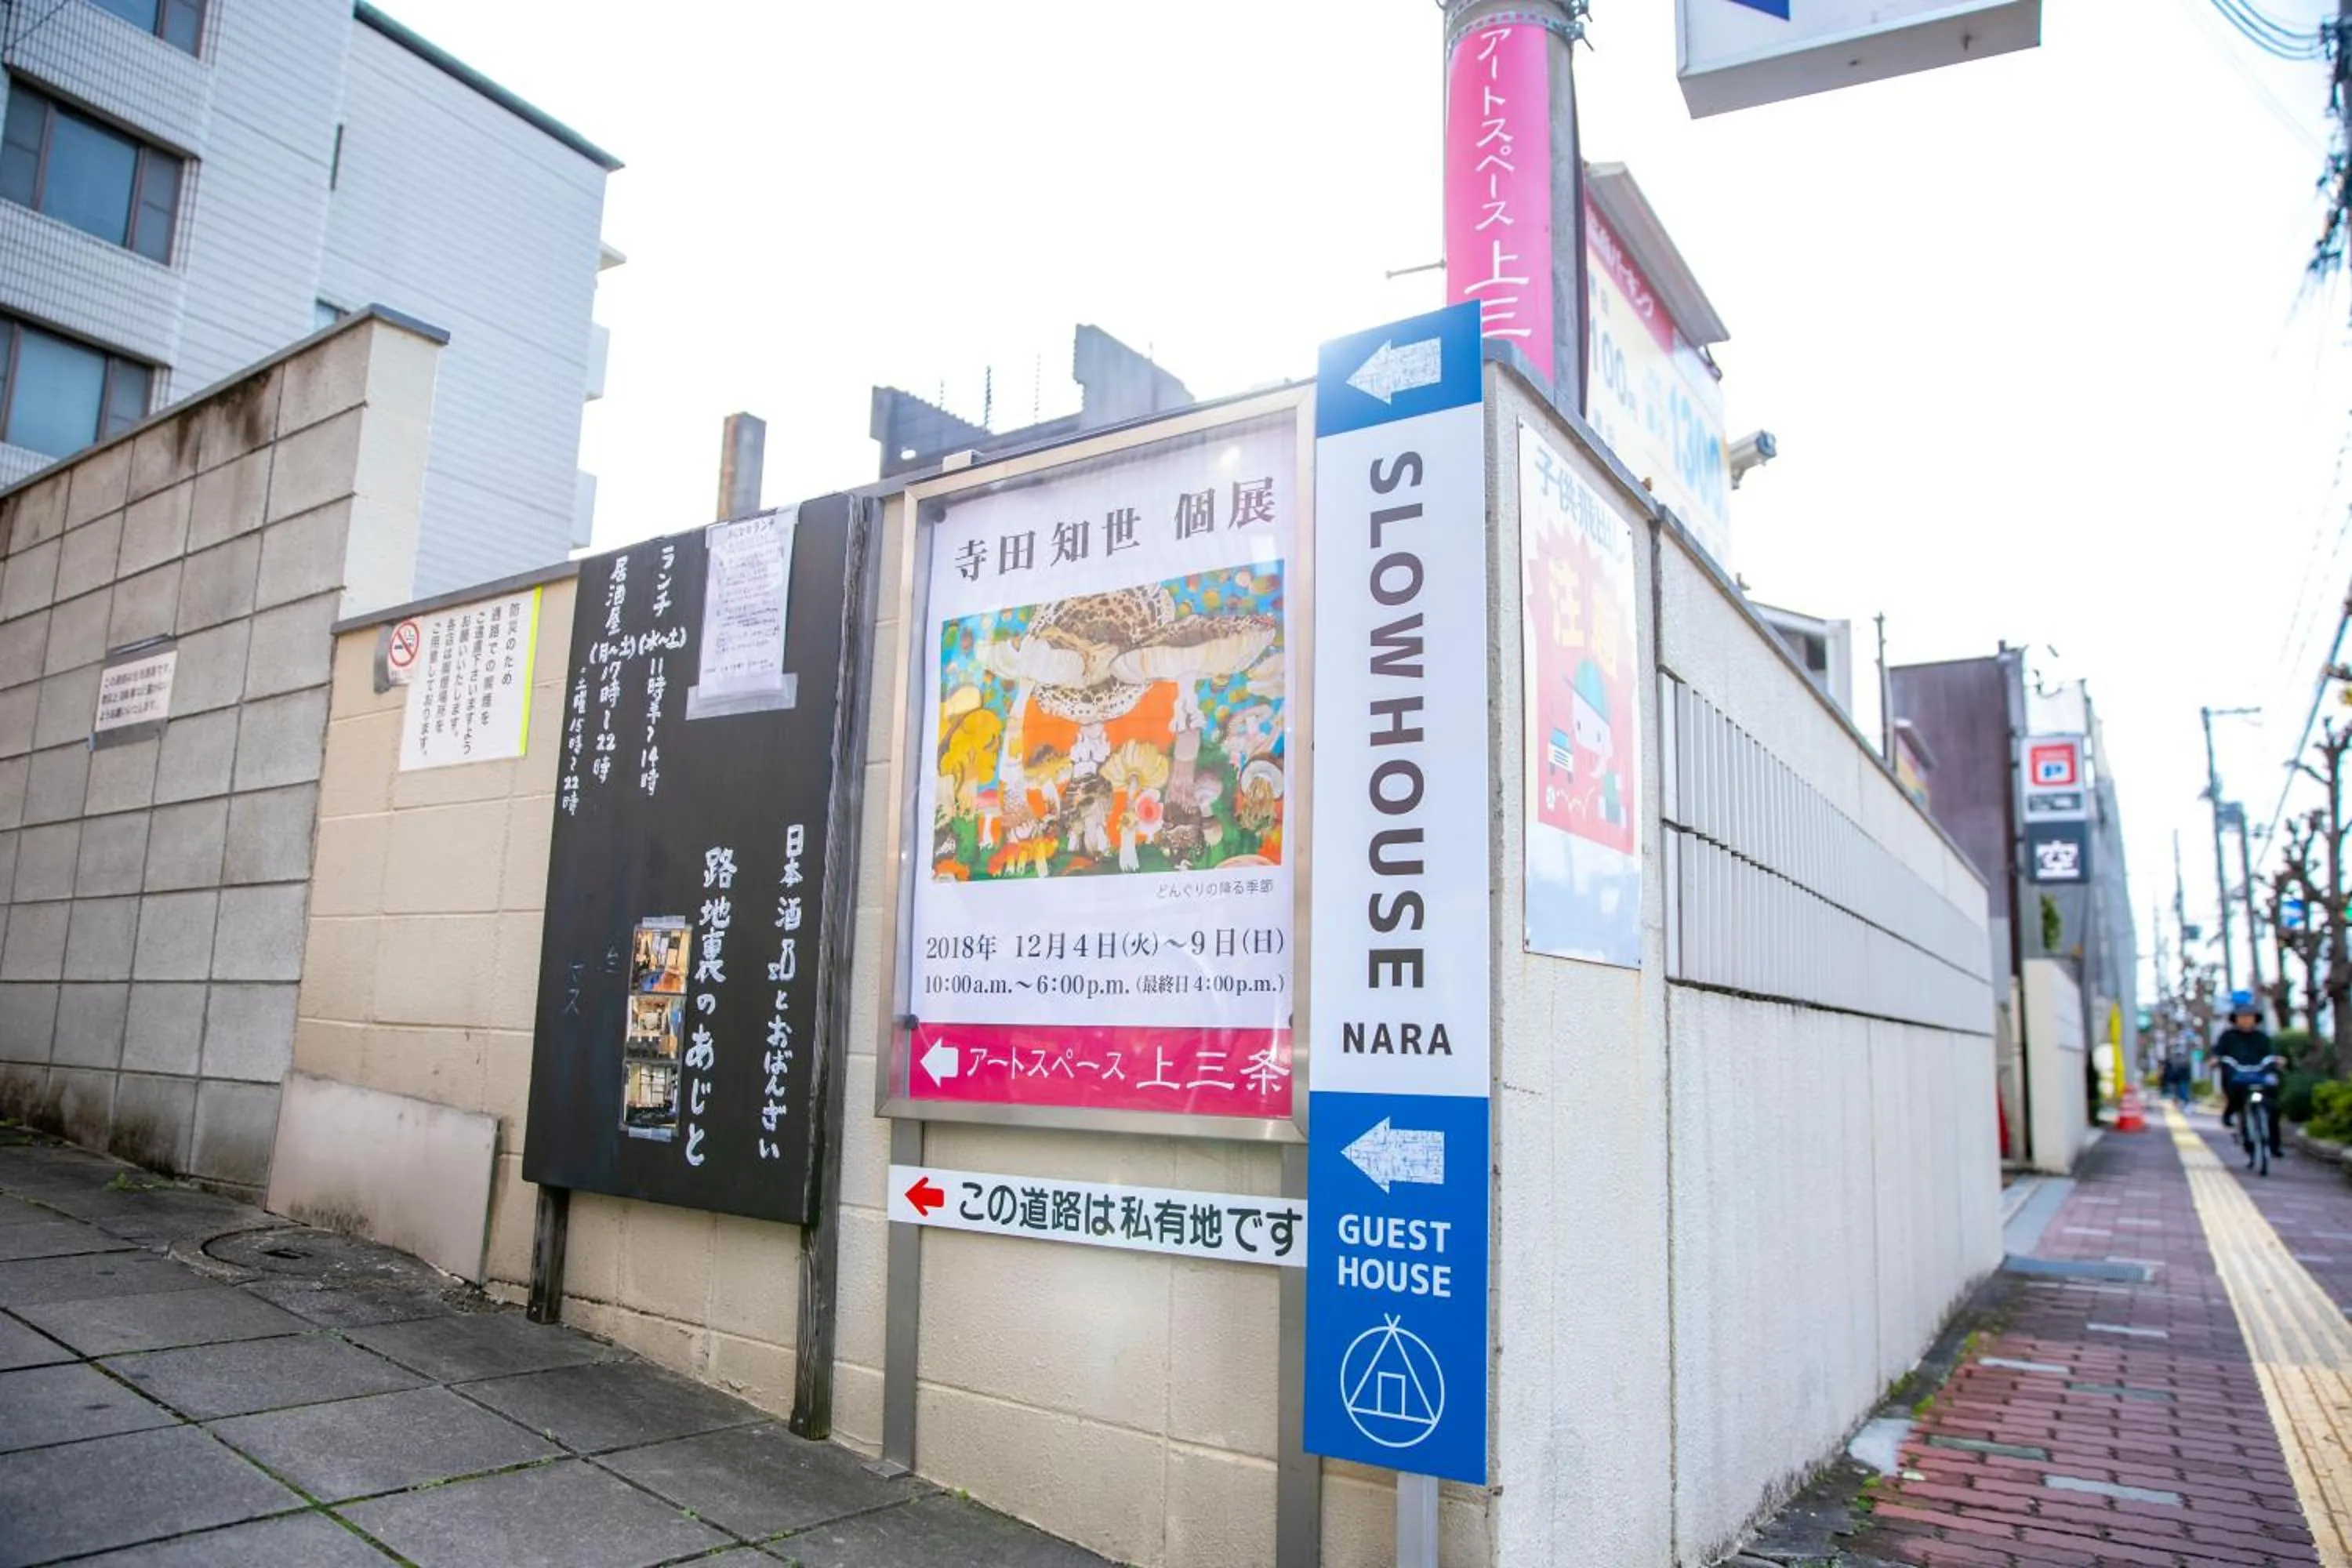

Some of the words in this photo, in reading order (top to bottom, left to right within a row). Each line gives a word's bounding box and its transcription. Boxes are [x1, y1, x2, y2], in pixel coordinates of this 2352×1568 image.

[1475, 27, 1515, 231] アートスペース
[953, 506, 1142, 583] 寺田知世
[1173, 475, 1276, 540] 個展
[604, 554, 629, 637] 居酒屋
[652, 545, 677, 618] ランチ
[2036, 840, 2081, 880] 空
[1156, 878, 1274, 899] どんぐりの降る季節
[925, 933, 998, 961] 2018年
[684, 844, 739, 1167] 路地裏のあじと
[1342, 1022, 1453, 1056] NARA
[966, 1045, 1126, 1081] アートスペース
[1135, 1046, 1292, 1096] 上三条
[959, 1181, 1303, 1257] この道路は私有地です
[1338, 1213, 1452, 1254] GUEST
[1338, 1254, 1452, 1298] HOUSE
